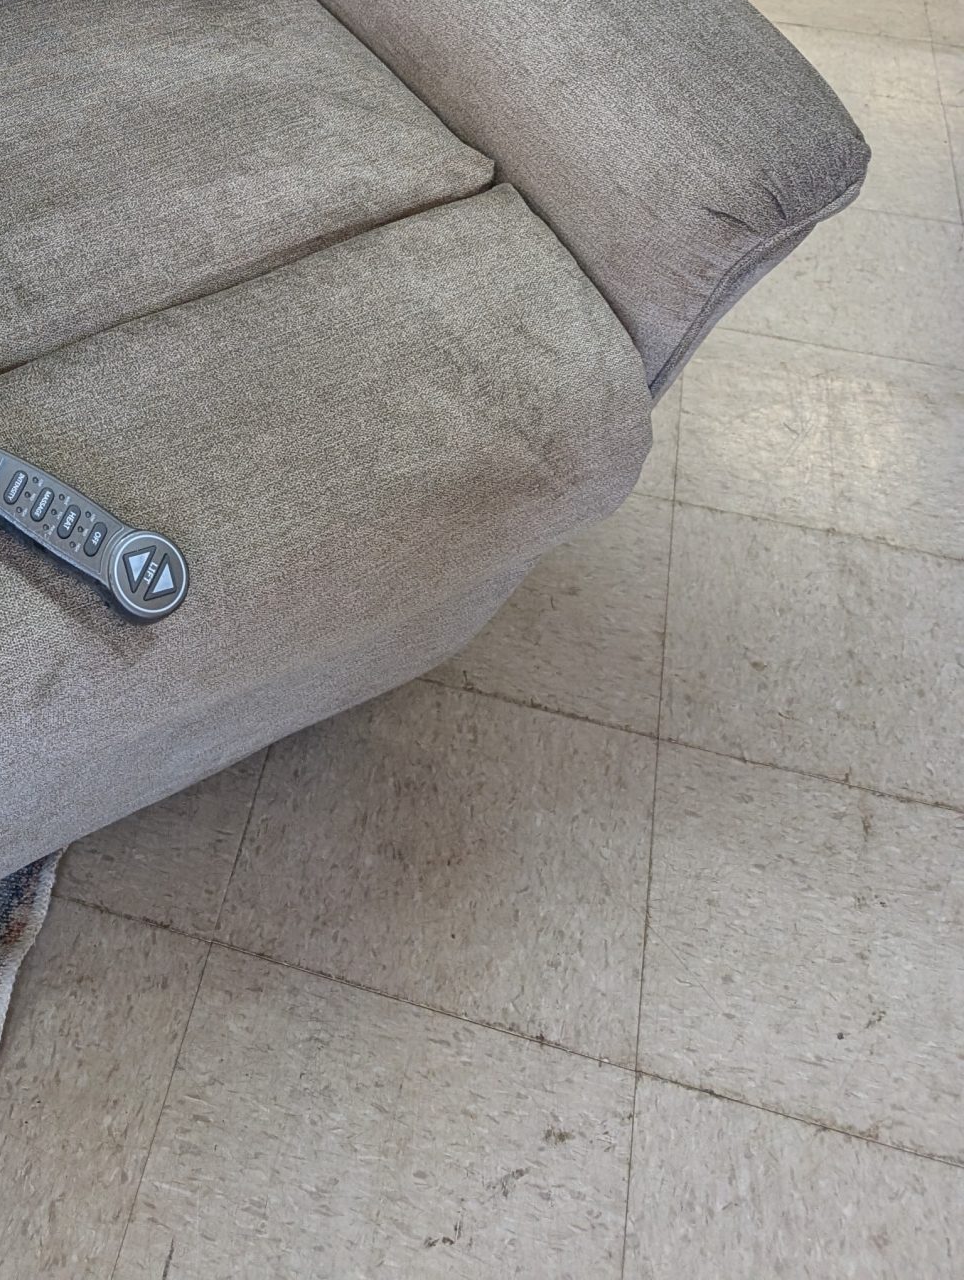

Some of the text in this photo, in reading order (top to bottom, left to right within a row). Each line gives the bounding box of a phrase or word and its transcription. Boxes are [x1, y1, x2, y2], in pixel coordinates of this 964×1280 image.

[7, 471, 26, 502] INTENSITY
[34, 489, 52, 518] MASSAGE
[63, 510, 77, 531] HEAT
[91, 531, 102, 546] OFF
[143, 561, 159, 585] LIFT
